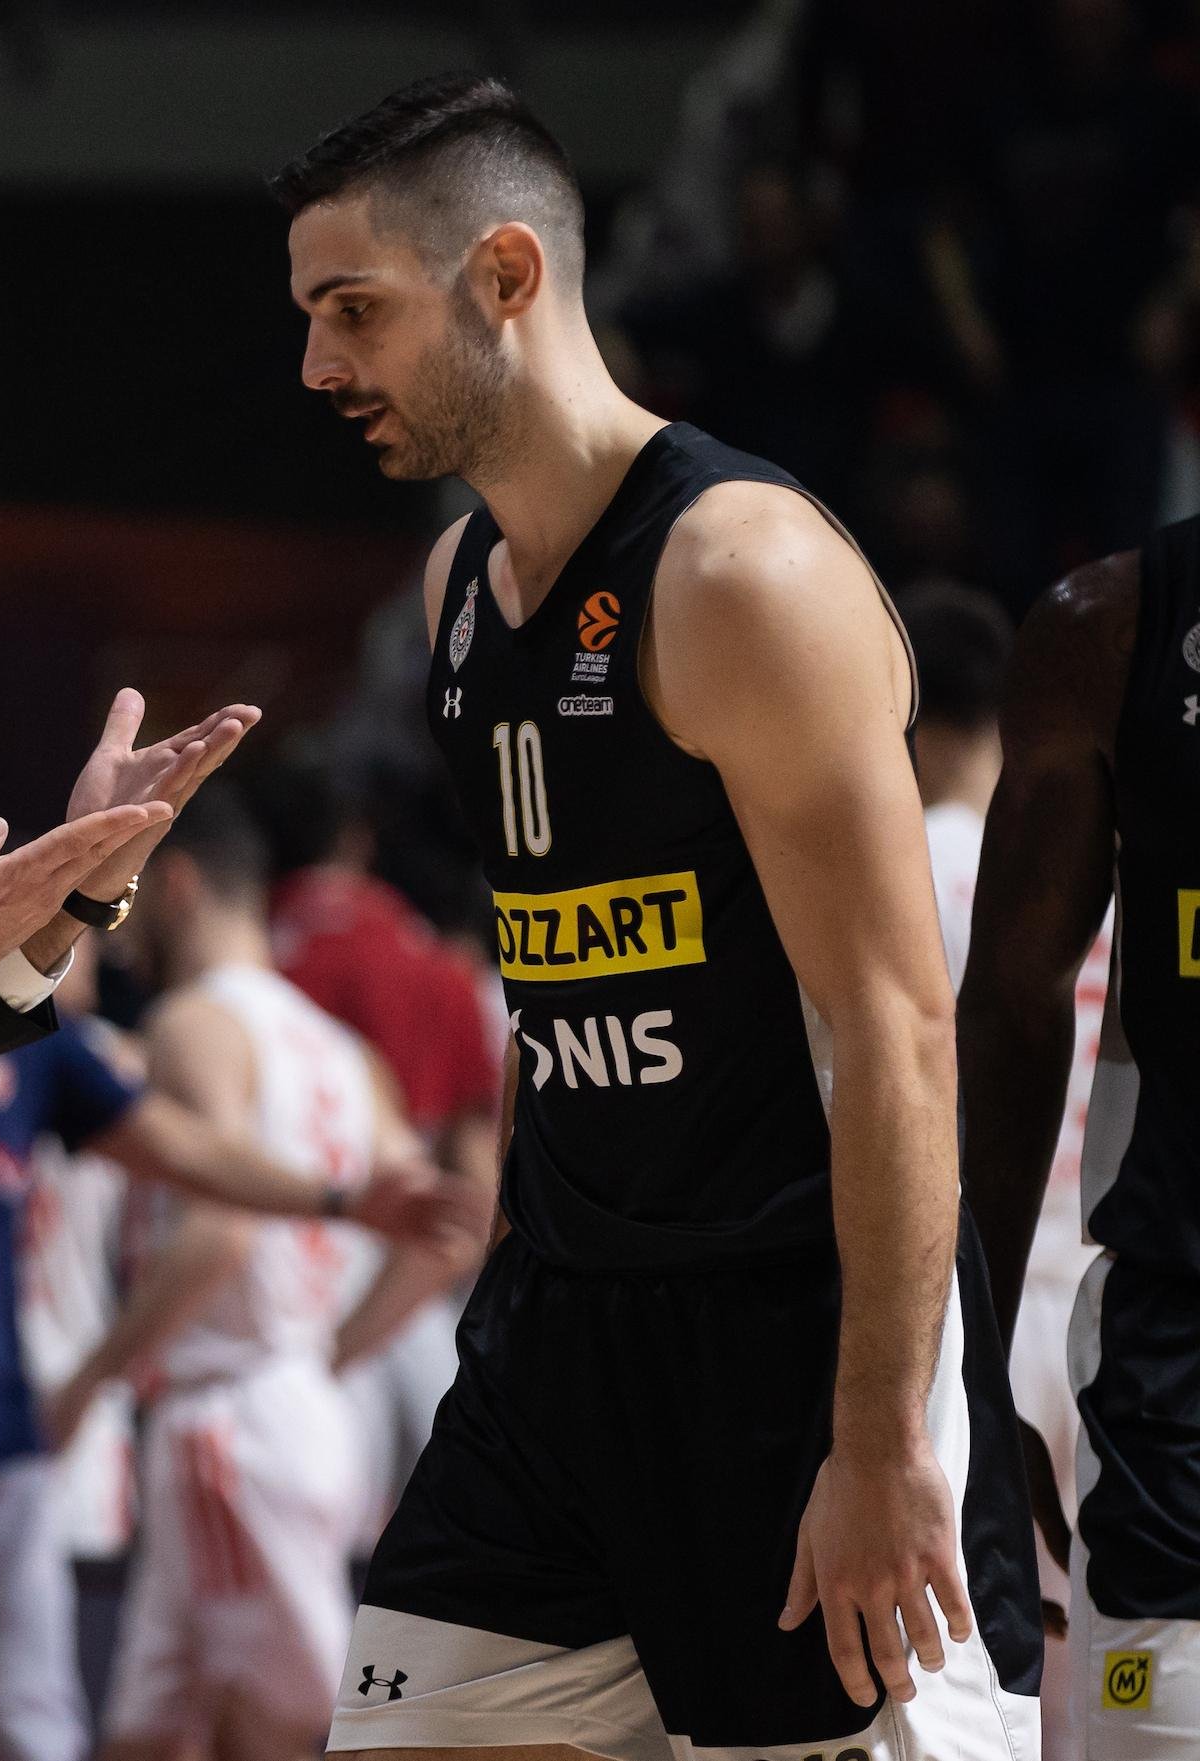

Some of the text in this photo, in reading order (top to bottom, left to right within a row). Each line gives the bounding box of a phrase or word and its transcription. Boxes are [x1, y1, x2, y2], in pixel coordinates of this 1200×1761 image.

[575, 652, 611, 664] TURKISH
[573, 662, 608, 674] AIRLINES
[559, 695, 613, 714] oneteam
[493, 720, 552, 857] 10
[553, 1009, 684, 1089] NIS
